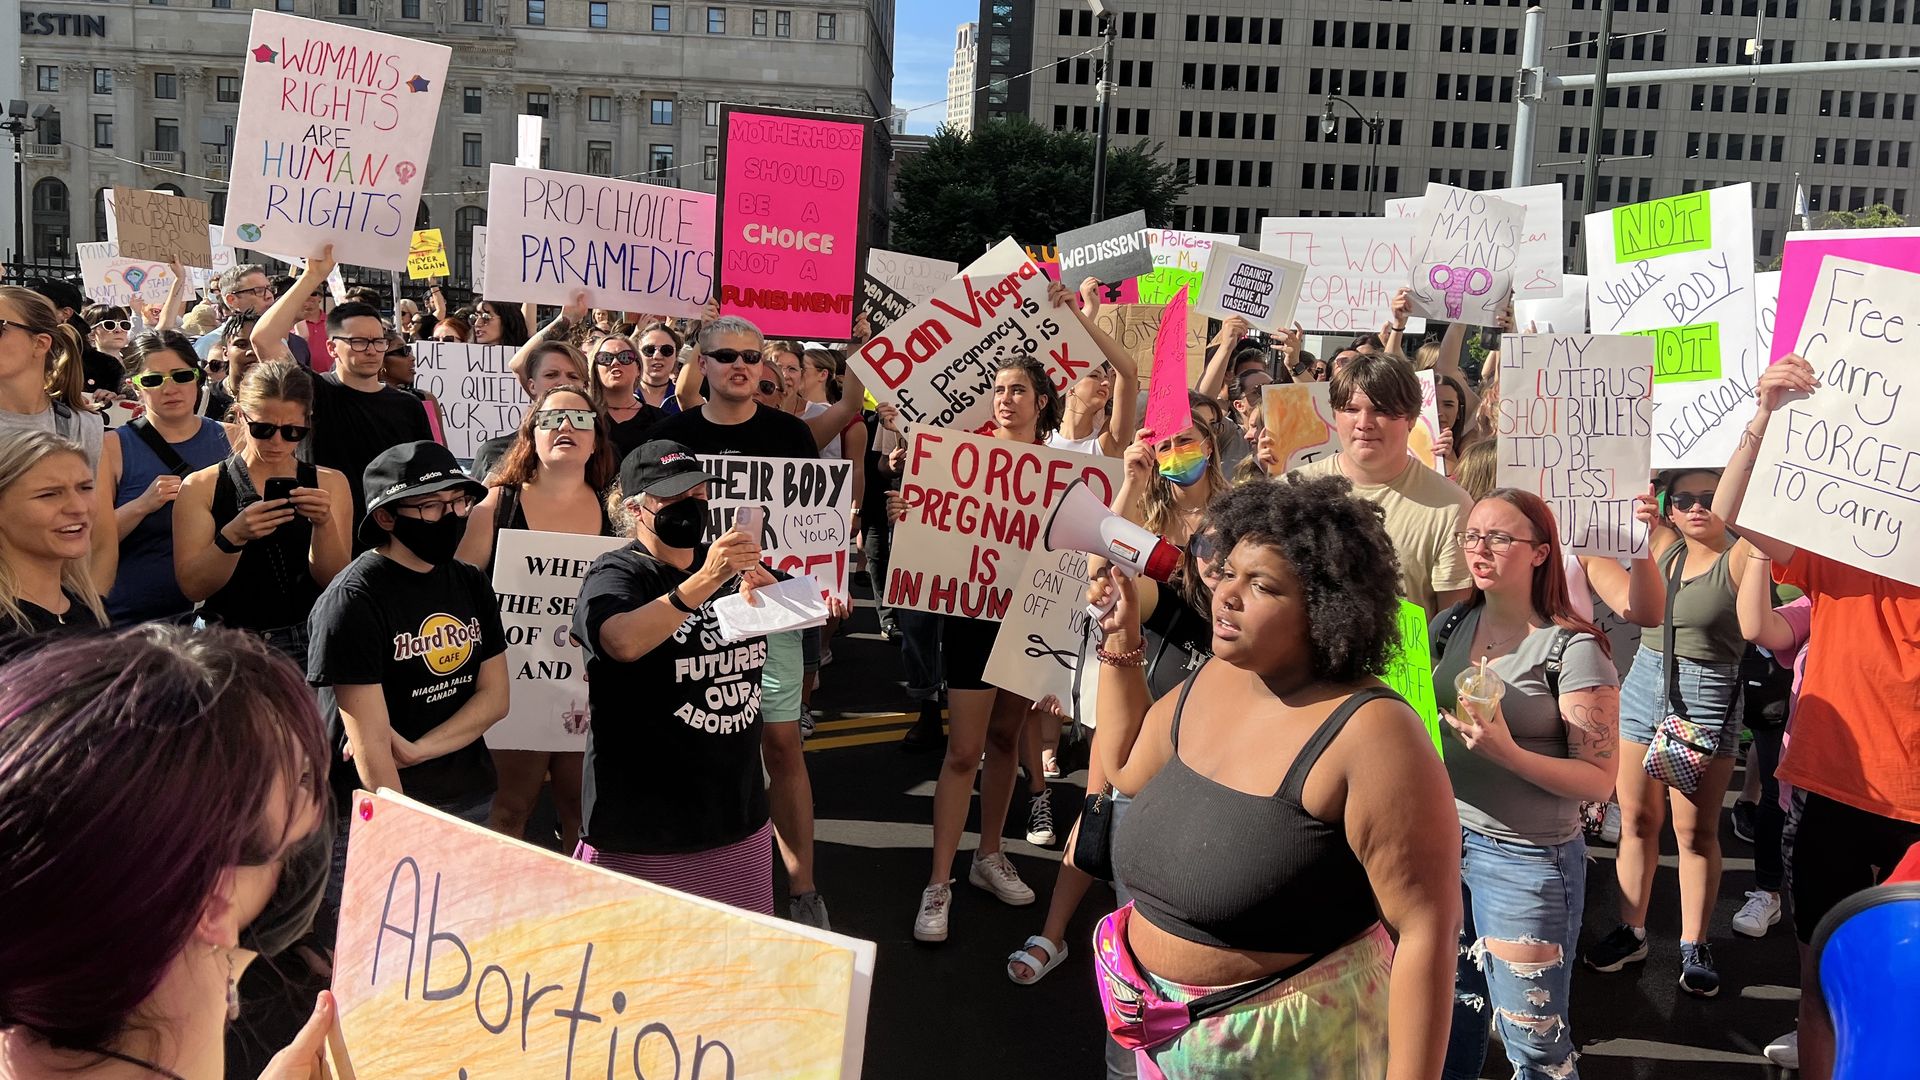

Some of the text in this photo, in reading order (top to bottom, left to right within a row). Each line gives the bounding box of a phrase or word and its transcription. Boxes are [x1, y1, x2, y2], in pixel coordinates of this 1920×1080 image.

[20, 12, 105, 38] ESTIN
[281, 37, 401, 91] WOMANS
[281, 77, 399, 131] RIGHTS
[302, 124, 351, 149] ARE
[729, 119, 863, 151] MOTHERHOOD
[263, 140, 389, 187] HUMAN
[744, 157, 844, 191] SHOULD
[116, 188, 207, 218] WE ARE NOT
[265, 184, 402, 237] RIGHTS
[523, 176, 698, 246] PRO-CHOICE
[738, 192, 819, 223] BE A
[1444, 189, 1486, 215] NO
[118, 206, 209, 237] INCUBATORS
[1430, 212, 1520, 249] MAN'S
[1620, 195, 1705, 256] NOT
[151, 228, 183, 249] FOR
[742, 223, 834, 255] CHOICE
[408, 255, 438, 266] NEVER
[417, 261, 446, 271] AGAIN
[521, 234, 713, 305] PARAMEDICS
[728, 250, 817, 280] NOT A
[1151, 253, 1172, 265] ver
[1421, 239, 1516, 273] LAND
[1230, 274, 1272, 294] ABORTION?
[1238, 264, 1272, 282] AGAINST
[1597, 259, 1665, 319] YOUR
[1663, 252, 1732, 324] BODY
[721, 285, 853, 315] PUNISHMENT
[1223, 295, 1268, 318] VASECTOMY
[1235, 286, 1261, 304] HAVE A
[1821, 268, 1905, 344] Free
[860, 261, 1038, 391] Ban Viagra
[1036, 317, 1060, 341] is
[1316, 304, 1377, 331] ROE!
[416, 342, 517, 374] WE WIL
[895, 388, 920, 422] if
[1020, 297, 1040, 318] is
[1502, 336, 1595, 369] IF MY
[461, 375, 534, 404] QUIETL
[1802, 332, 1903, 426] Carry
[1499, 397, 1563, 436] SHOT
[1657, 348, 1755, 460] DECISION
[1570, 434, 1602, 472] BE
[1785, 408, 1920, 493] FORCED
[386, 483, 407, 495] adidas
[420, 471, 442, 482] adidas
[783, 461, 851, 508] BODY
[1556, 498, 1649, 554] ULATED
[1774, 463, 1903, 559] TO Carry
[968, 545, 1000, 586] IS
[1032, 568, 1064, 595] CAN
[494, 592, 578, 616] THE SE
[1023, 593, 1057, 618] OFF
[394, 617, 481, 661] Hard Rock
[505, 625, 542, 646] OF
[439, 651, 460, 665] CAFE
[516, 660, 573, 681] AND
[674, 640, 767, 683] FUTURES
[412, 674, 473, 698] NIAGARA FALLS
[426, 687, 457, 704] CANADA
[705, 681, 752, 711] OUR
[673, 683, 763, 735] ABORTIONS
[372, 856, 735, 1080] Abortion
